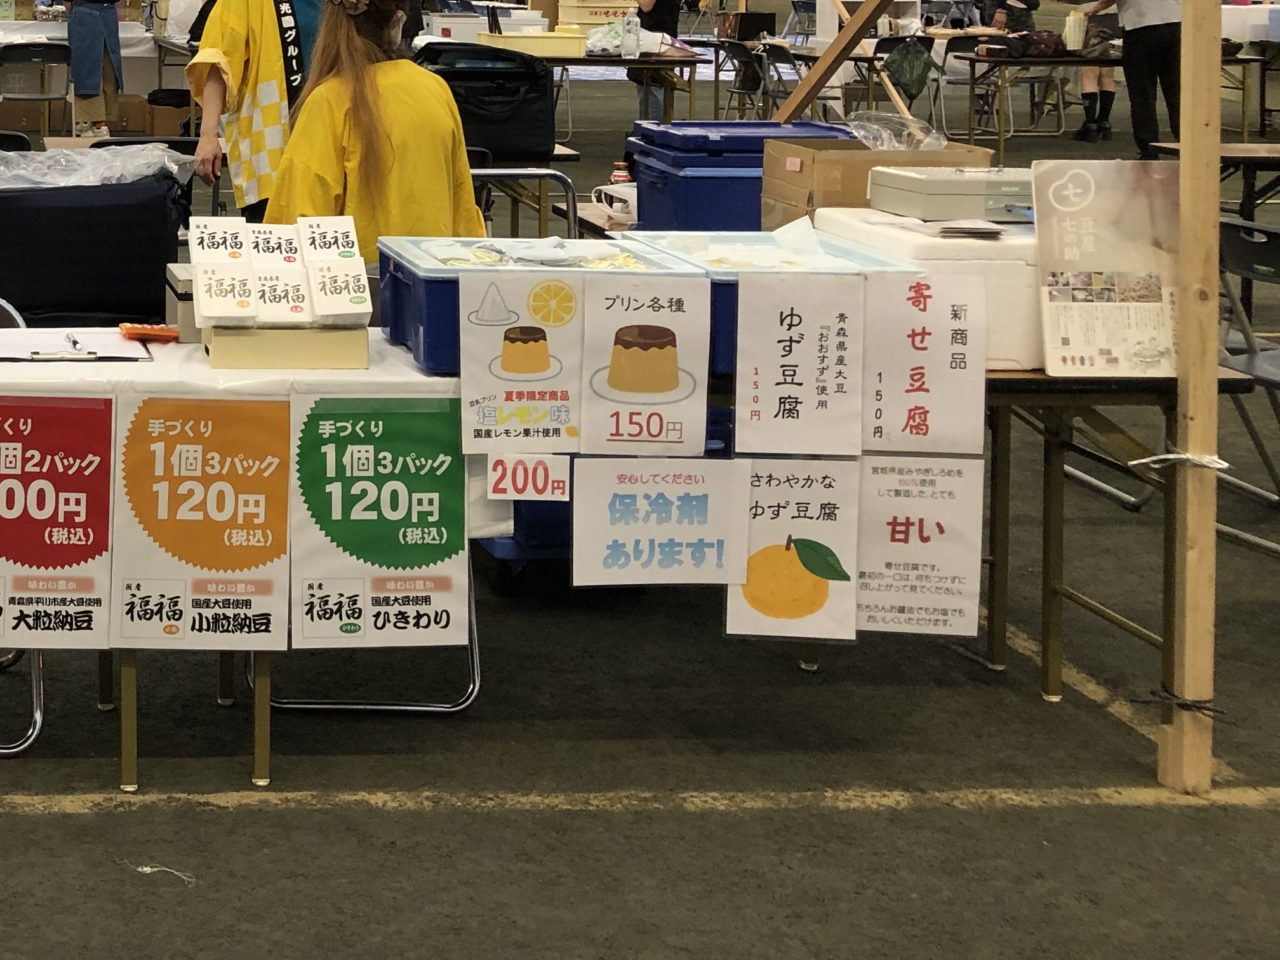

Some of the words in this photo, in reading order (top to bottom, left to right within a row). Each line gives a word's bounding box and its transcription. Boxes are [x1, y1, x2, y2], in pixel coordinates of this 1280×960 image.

[196, 231, 243, 250] 福福
[251, 235, 298, 255] 福福
[307, 230, 355, 251] 福福
[204, 276, 252, 299] 福福
[257, 282, 306, 305] 福福
[317, 273, 367, 296] 福福
[604, 294, 686, 313] プリン各種
[949, 303, 968, 370] 新商品
[773, 306, 805, 420] ゆず豆腐
[834, 312, 848, 394] 青森県産大豆
[901, 281, 933, 436] 寄せ豆腐
[504, 390, 570, 401] 夏季限定商品
[750, 367, 761, 420] 150円
[873, 371, 883, 439] 150円
[477, 405, 571, 426] 塩レモン味
[608, 410, 684, 440] 150円
[147, 418, 213, 438] 手づくり
[318, 419, 384, 439] 手づくり
[473, 428, 561, 438] 国産レモン果汁使用
[149, 441, 280, 478] 1個3パック
[320, 442, 452, 478] 1個3パック
[491, 458, 566, 495] 200円
[616, 473, 705, 485] 安心してください
[750, 472, 837, 490] さわやかな
[151, 480, 267, 525] 120円
[324, 480, 440, 523] 120円
[608, 492, 709, 526] 保冷剤
[749, 502, 840, 522] ゆず豆腐
[44, 527, 95, 546] （税込）
[223, 529, 273, 547] （税込）
[399, 527, 447, 545] （税込）
[886, 515, 946, 544] 甘い
[602, 537, 726, 570] あります！
[124, 593, 183, 622] 福福
[191, 598, 252, 610] 国産大豆使用
[304, 593, 363, 622] 福福
[371, 595, 431, 606] 国産大豆使用
[11, 609, 94, 632] 大粒納豆
[190, 612, 272, 634] 小粒納豆
[372, 609, 451, 630] ひきわり
